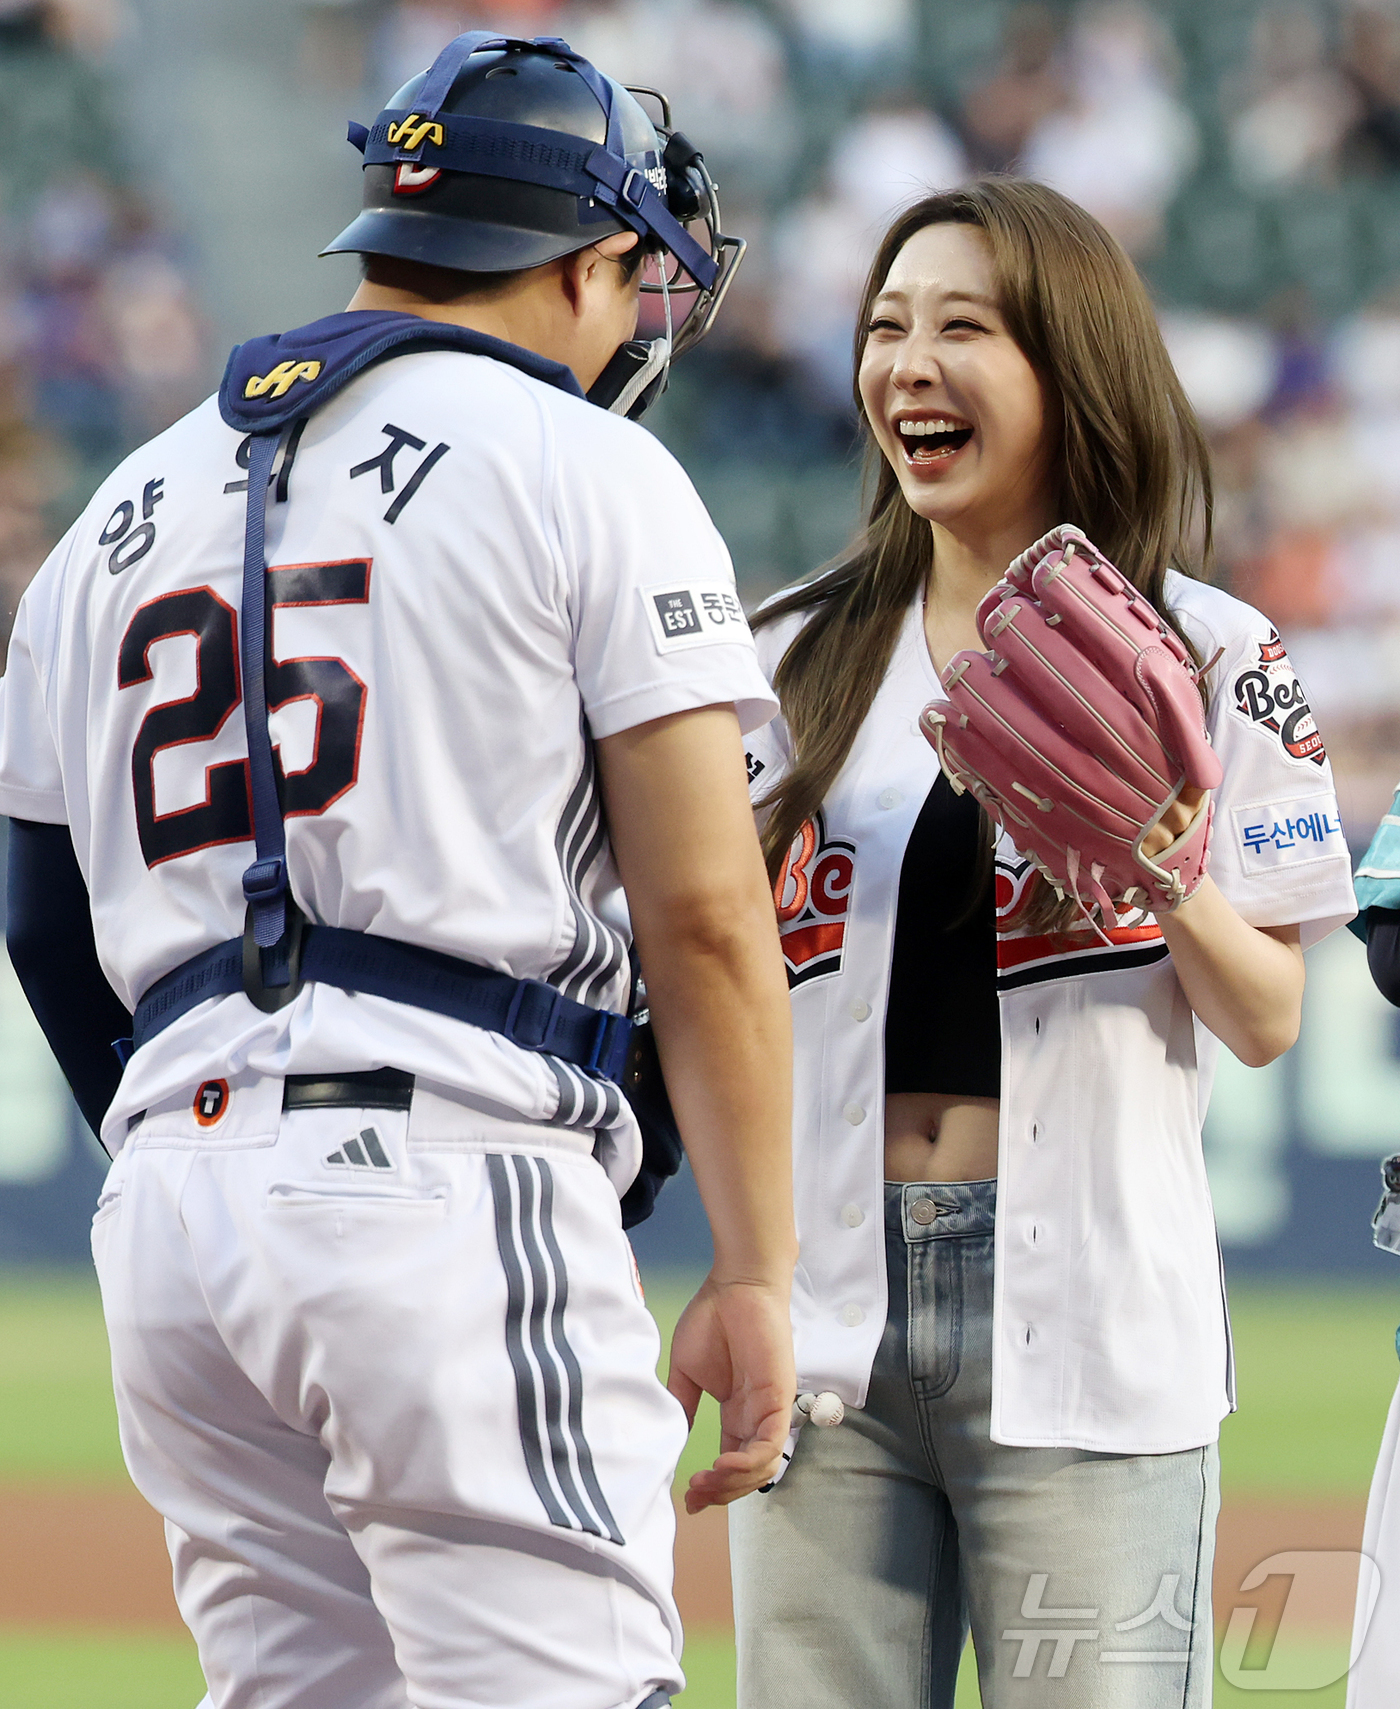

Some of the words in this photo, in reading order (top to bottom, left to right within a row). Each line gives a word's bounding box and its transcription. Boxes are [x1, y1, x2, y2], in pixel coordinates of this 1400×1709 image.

[668, 599, 683, 609] THE
[664, 609, 694, 631] EST
[118, 557, 373, 871] 25
